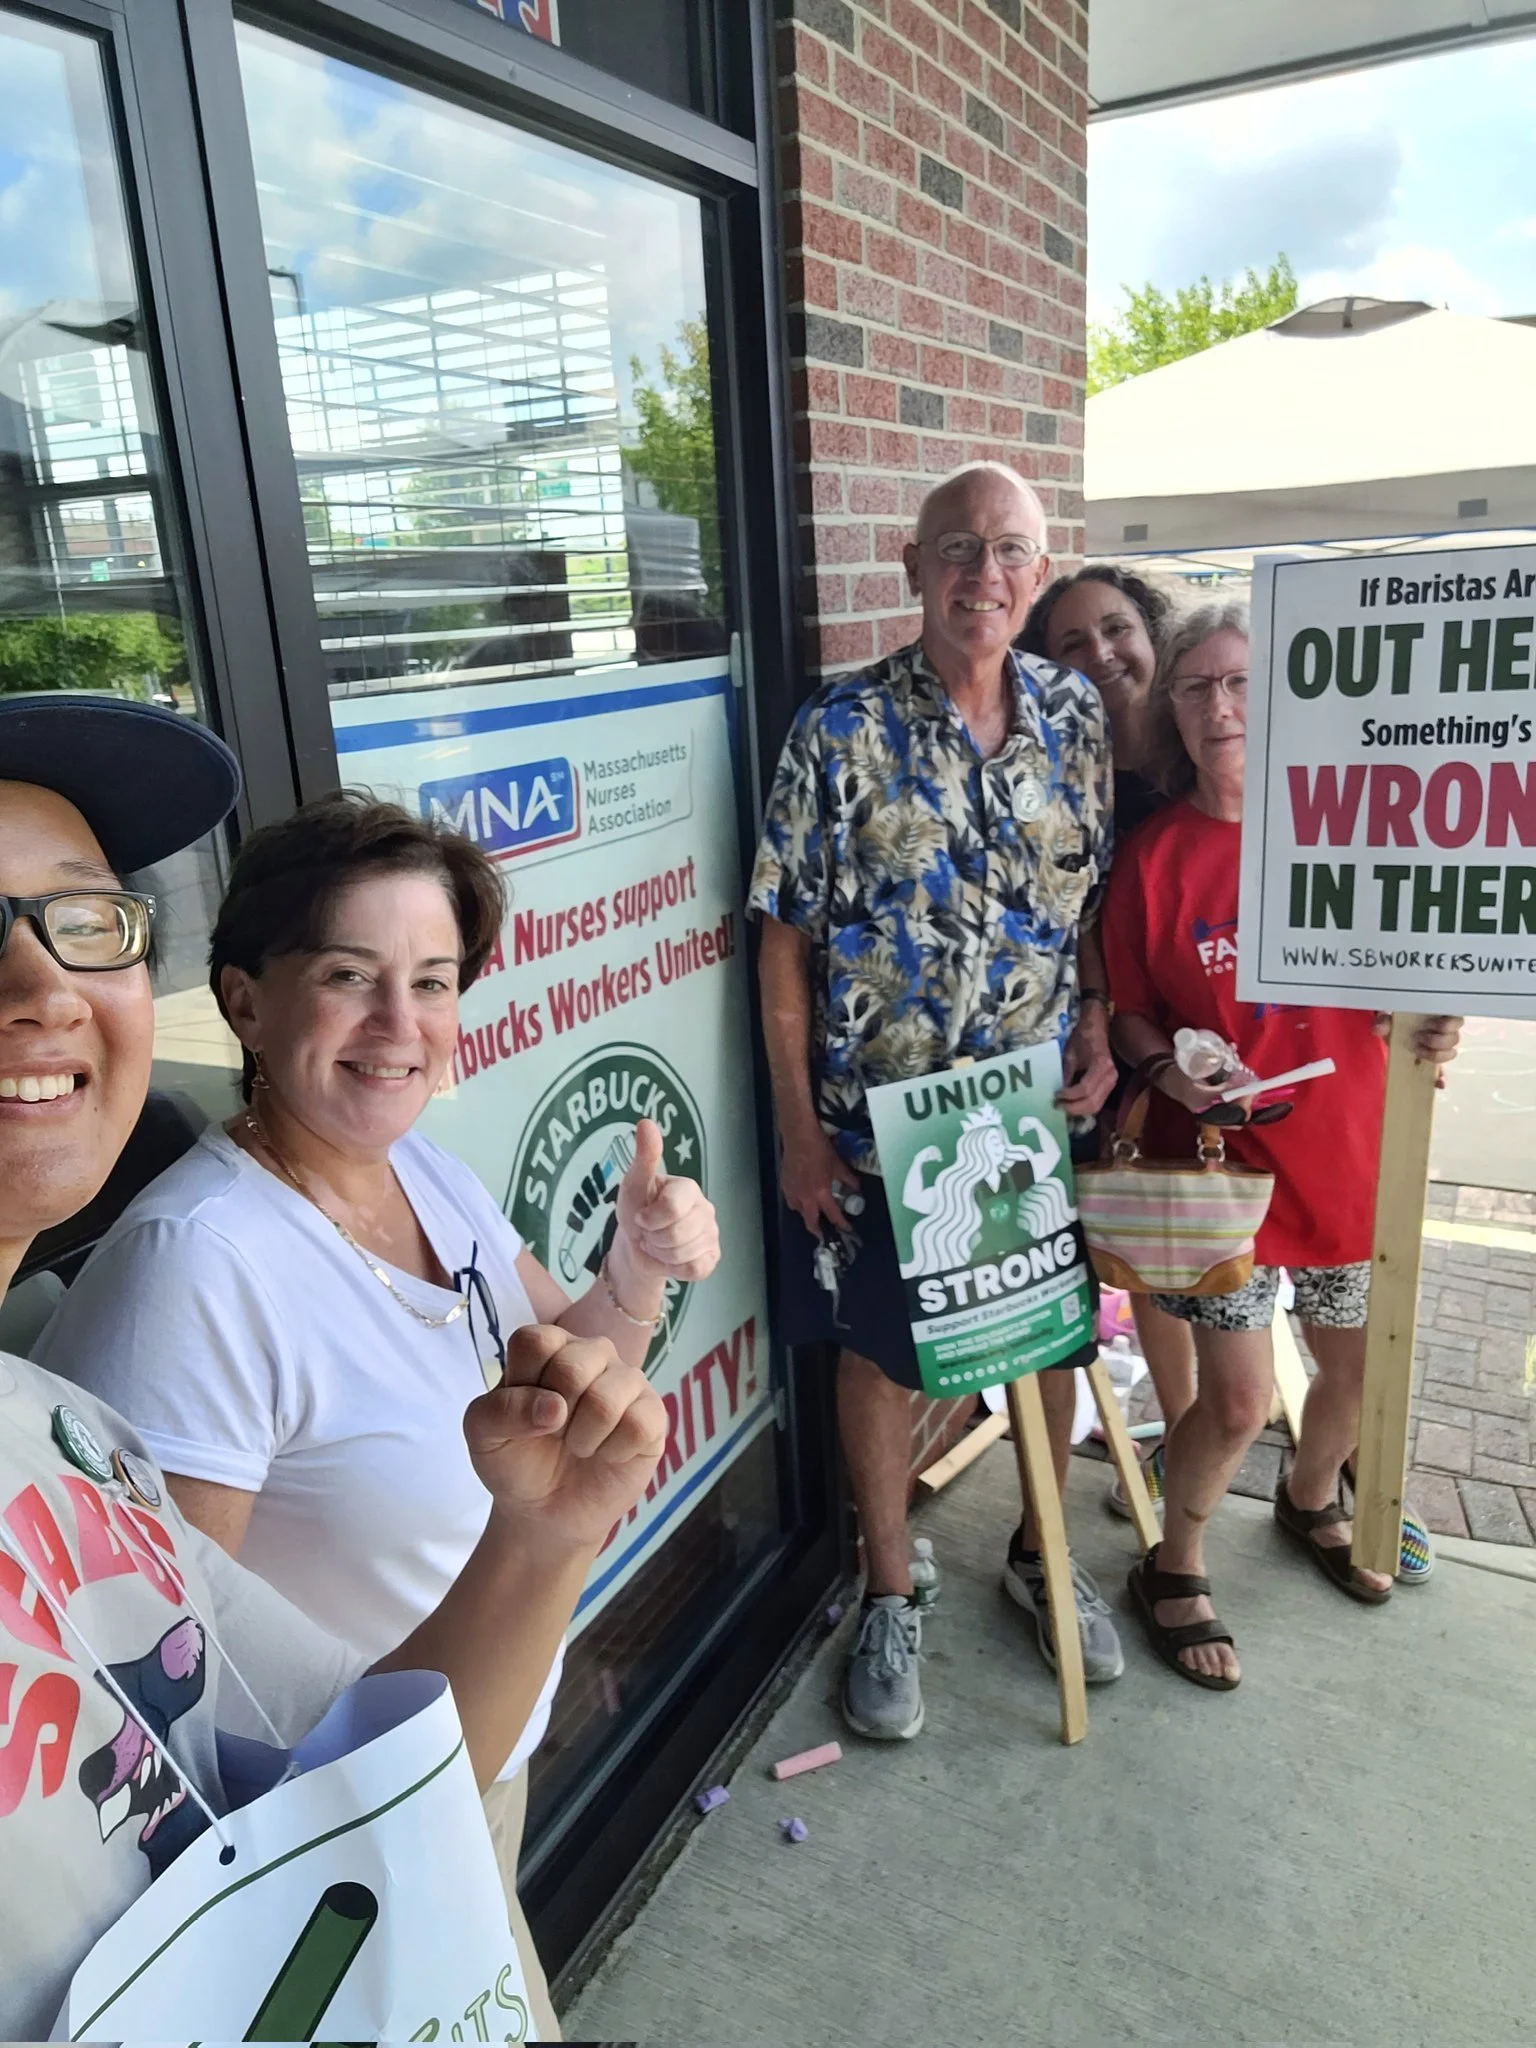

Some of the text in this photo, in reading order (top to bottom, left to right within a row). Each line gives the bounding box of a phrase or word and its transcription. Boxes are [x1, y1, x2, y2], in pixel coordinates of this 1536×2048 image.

[1359, 577, 1380, 608] If
[1385, 573, 1497, 606] Baristas
[1287, 616, 1536, 700] OUT HE
[583, 743, 688, 783] Massachusetts
[1361, 713, 1532, 749] Something's
[429, 775, 564, 842] MNA
[585, 780, 637, 809] Nurses
[587, 797, 673, 837] Association
[1286, 761, 1536, 850] WRON
[513, 896, 607, 967] Nurses
[612, 855, 697, 929] support
[1288, 863, 1536, 935] IN THER
[547, 956, 653, 1036] Workers
[655, 911, 737, 986] United!
[1197, 932, 1239, 967] FA
[904, 1059, 1033, 1121] UNION
[524, 1070, 679, 1211] STARBUCKS
[916, 1231, 1078, 1314] STRONG
